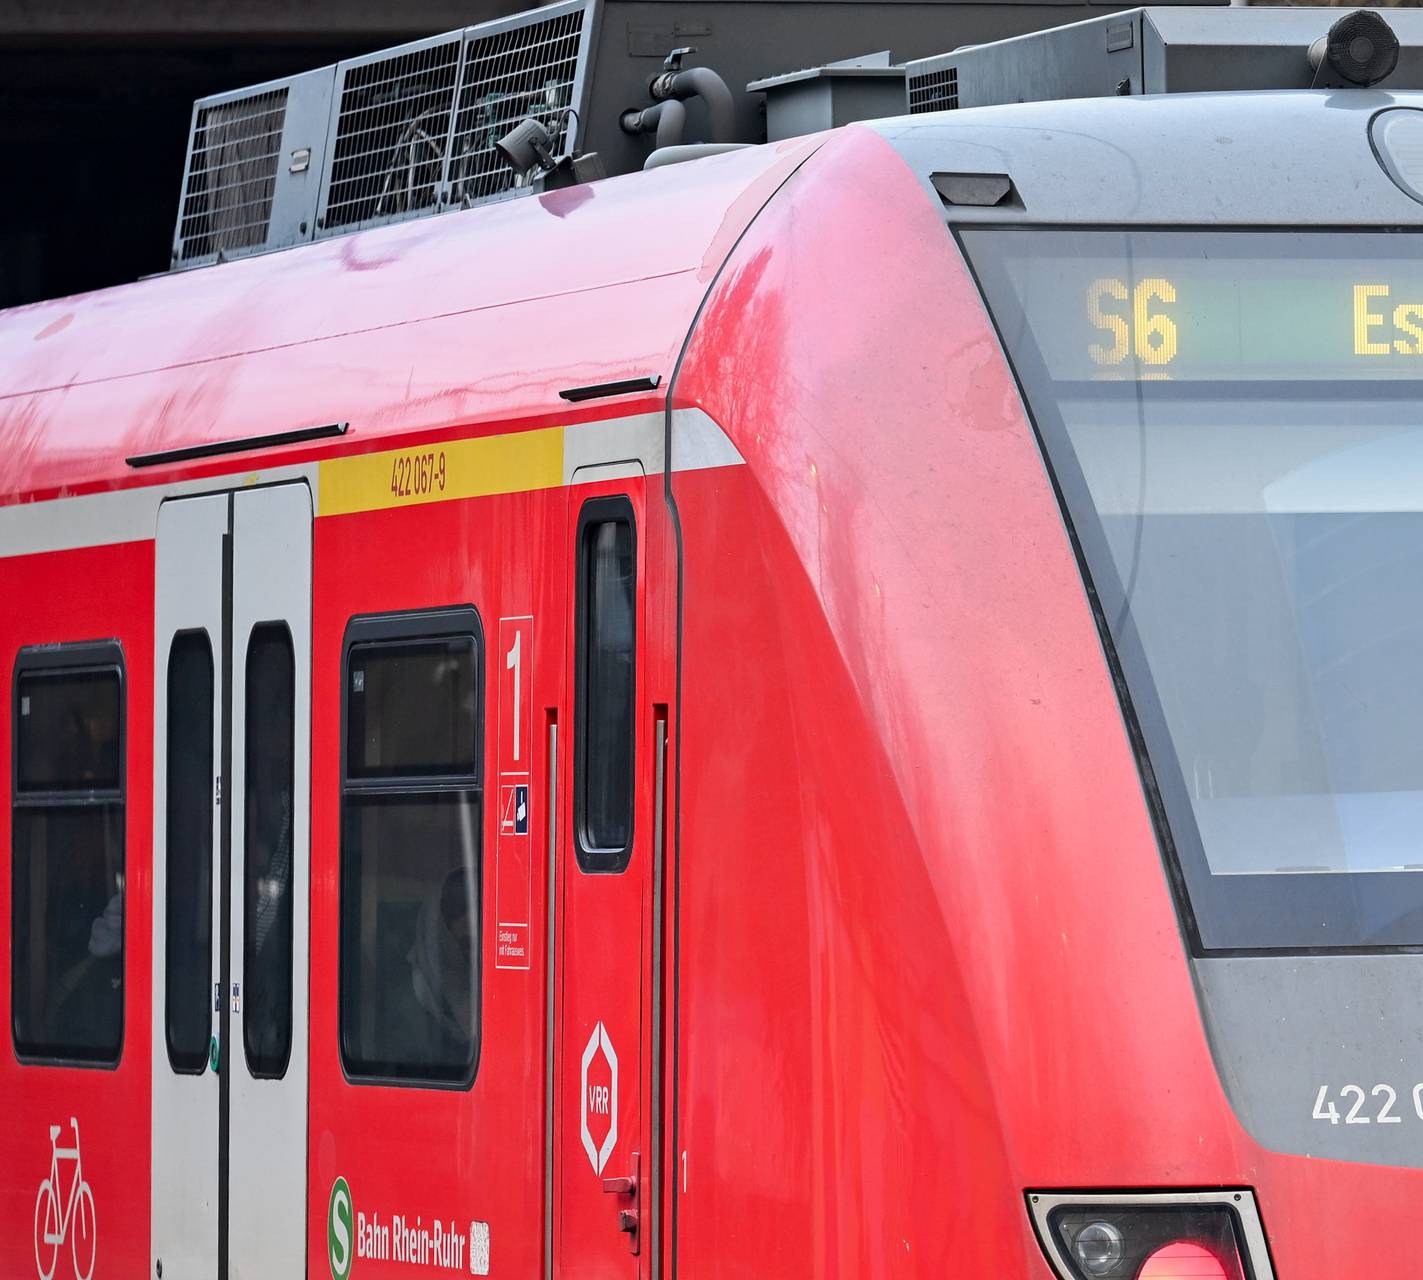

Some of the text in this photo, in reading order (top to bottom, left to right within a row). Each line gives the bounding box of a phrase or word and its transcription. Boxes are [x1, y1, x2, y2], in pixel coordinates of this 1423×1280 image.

[1088, 279, 1177, 365] S6
[391, 451, 446, 497] 422 067-9
[506, 630, 521, 761] 1
[589, 1085, 609, 1115] VRR
[1312, 1083, 1402, 1125] 422
[332, 1189, 466, 1276] S Bahn Rhein-Ruhr
